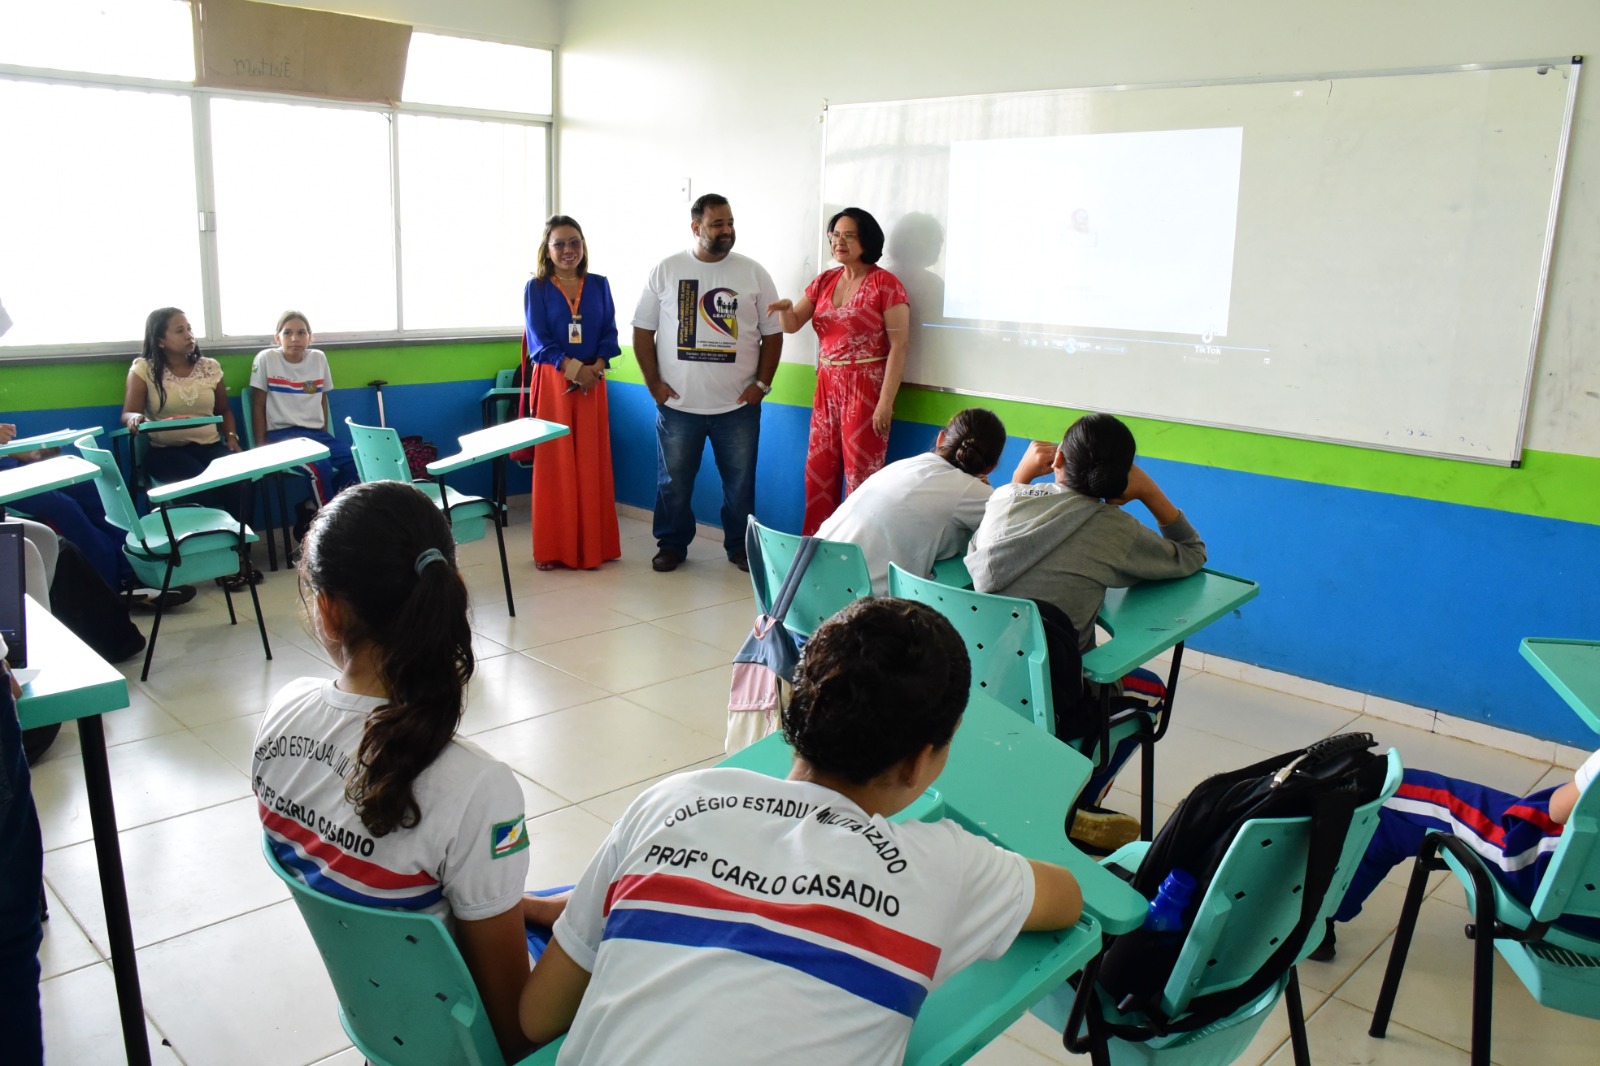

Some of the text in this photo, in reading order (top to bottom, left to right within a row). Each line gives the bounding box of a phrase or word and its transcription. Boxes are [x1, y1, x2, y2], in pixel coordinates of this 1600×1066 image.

[1194, 345, 1222, 356] TikTok
[275, 795, 315, 828] CARLO
[318, 815, 375, 857] CASADIO
[664, 795, 907, 874] COLÉGIO ESTADU MILITAIZADO
[644, 844, 900, 918] PROFº CARLO CASADIO
